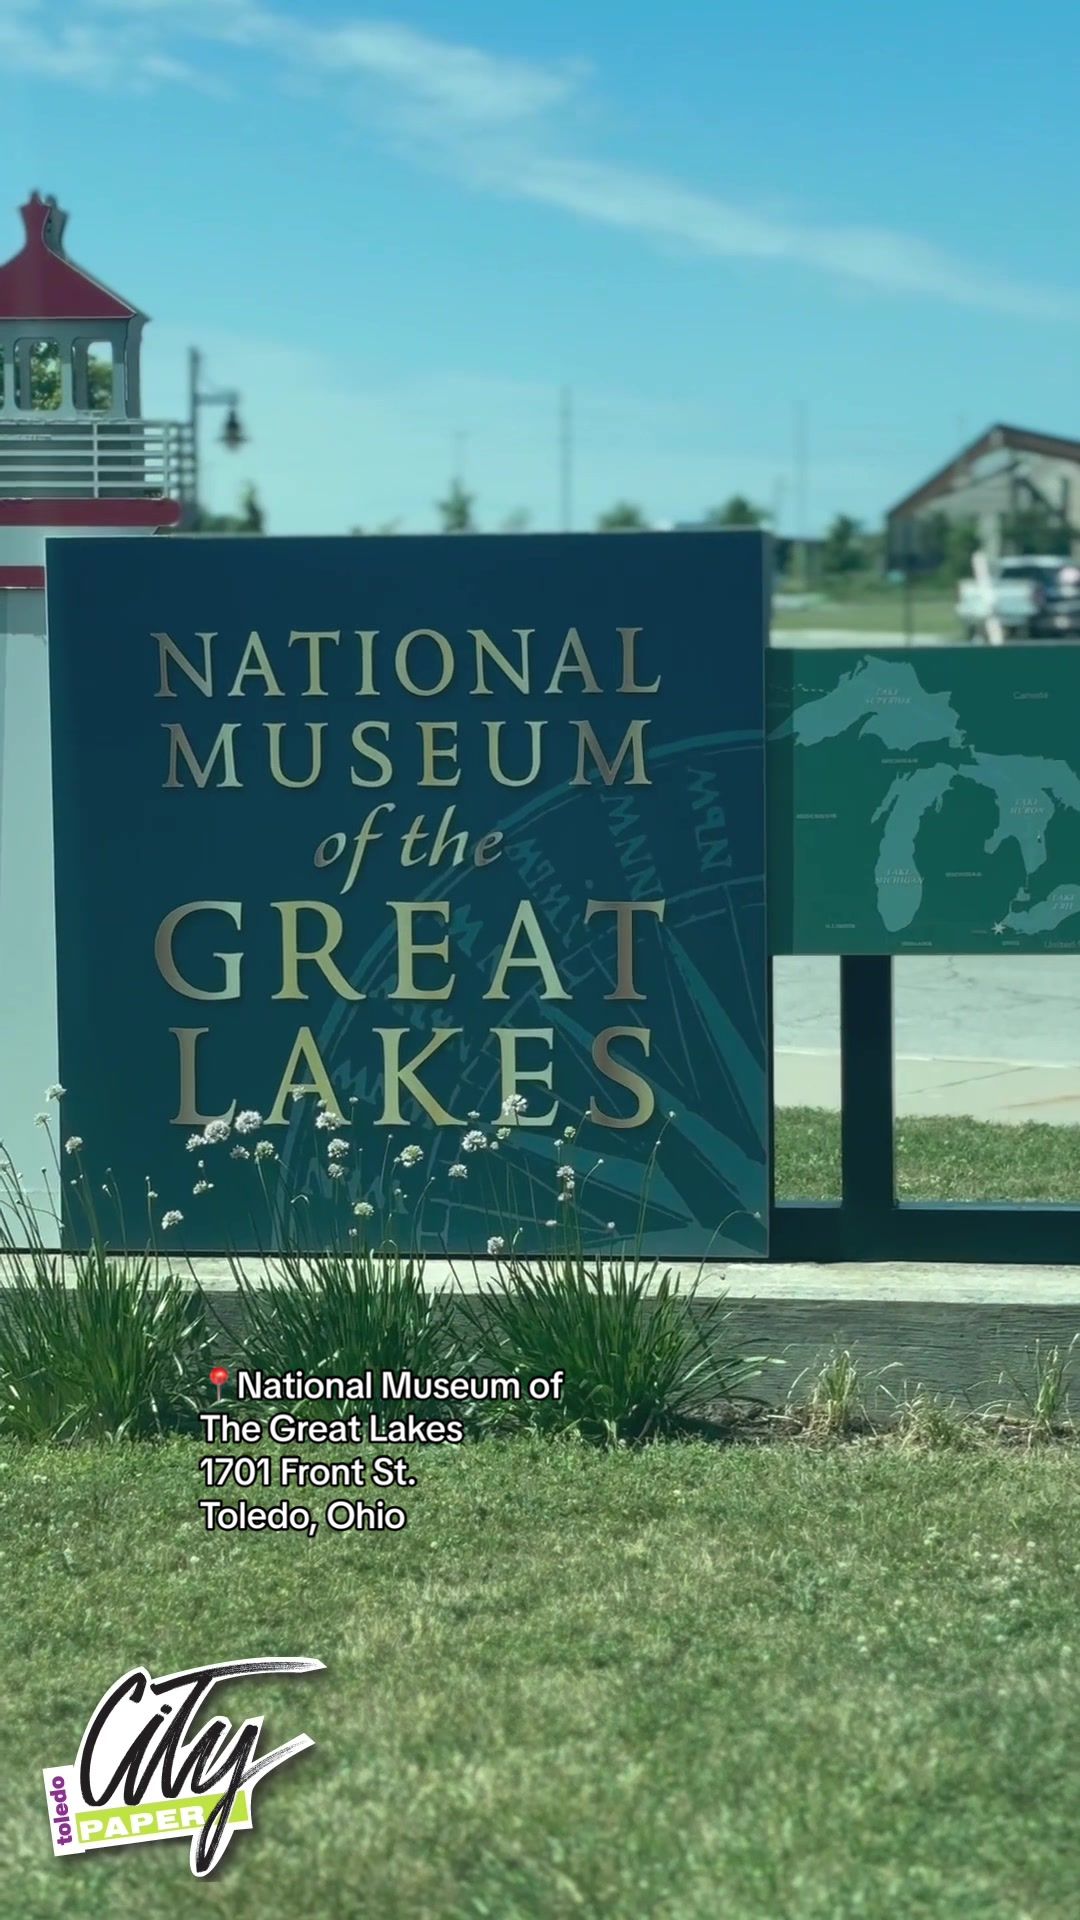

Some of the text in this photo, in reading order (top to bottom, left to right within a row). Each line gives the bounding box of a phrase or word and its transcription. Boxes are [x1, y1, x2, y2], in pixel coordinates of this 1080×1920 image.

[149, 626, 662, 698] NATIONAL
[160, 719, 652, 788] MUSEUM
[313, 802, 504, 895] of the
[154, 898, 666, 1001] GREAT
[168, 1025, 656, 1129] LAKES
